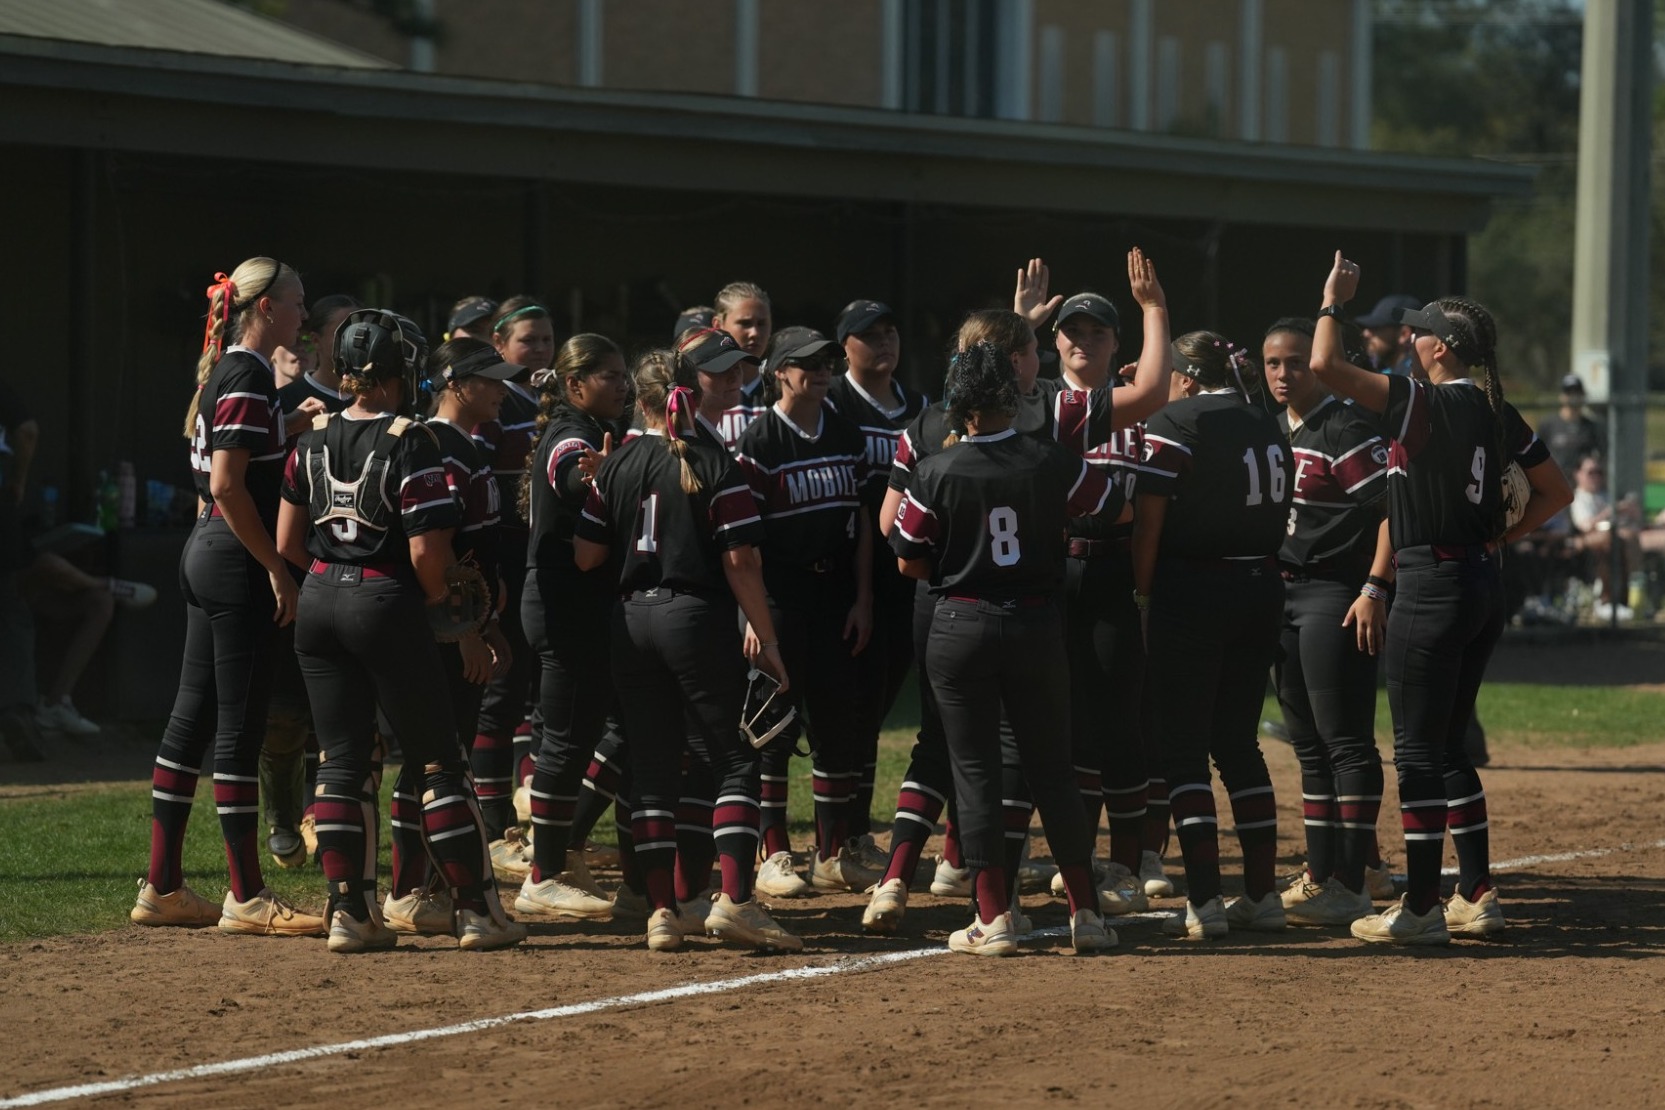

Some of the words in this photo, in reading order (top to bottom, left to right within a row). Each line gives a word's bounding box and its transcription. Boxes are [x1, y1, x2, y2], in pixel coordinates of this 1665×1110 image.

[785, 464, 858, 504] MOBILE
[1243, 443, 1286, 506] 16
[1465, 445, 1487, 505] 9
[635, 492, 659, 554] 1
[988, 505, 1021, 567] 8
